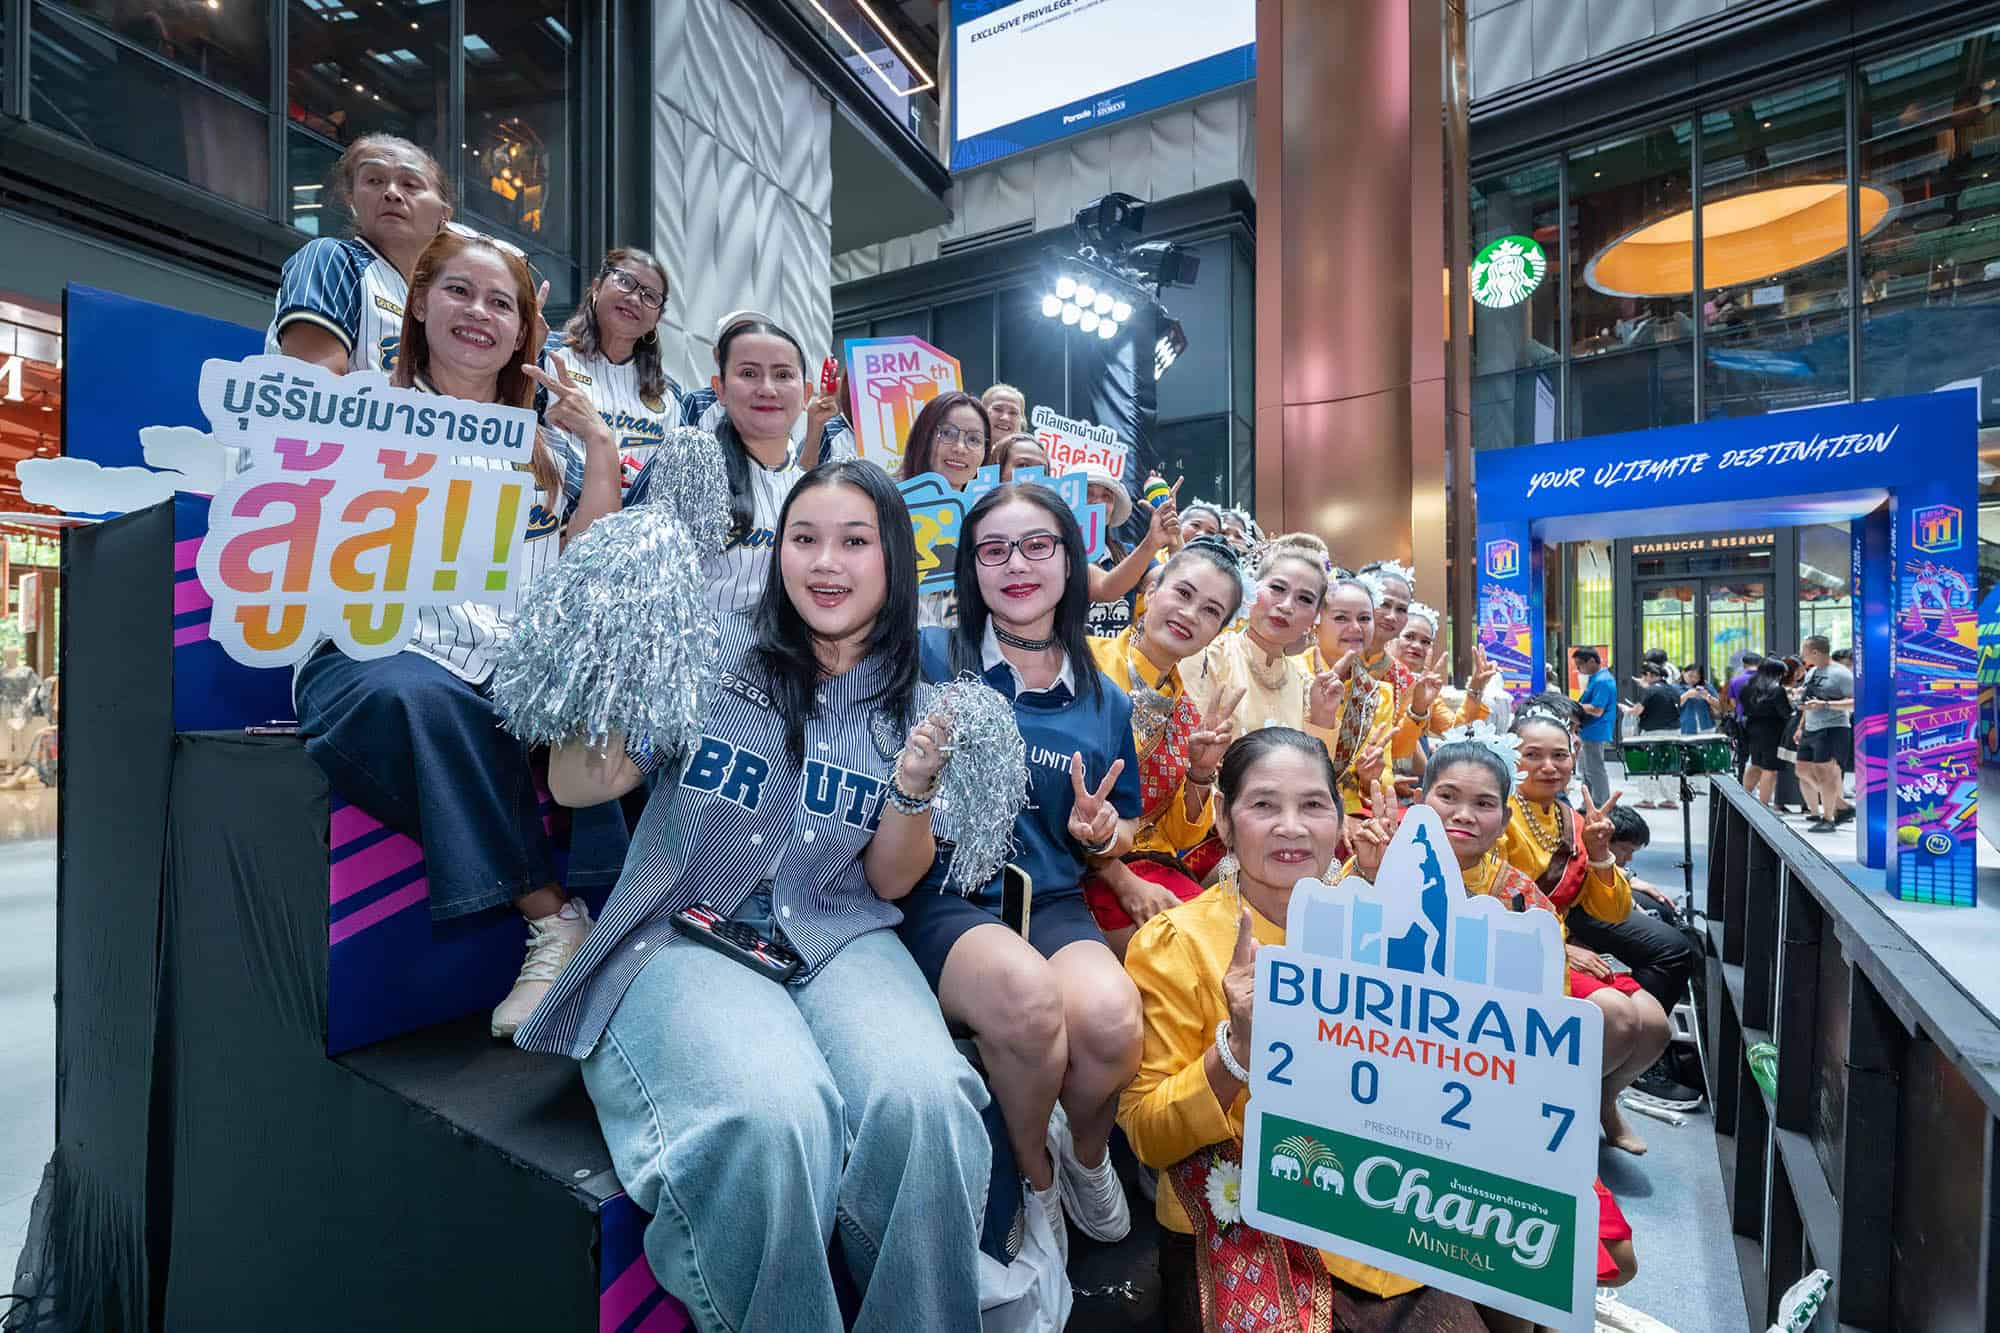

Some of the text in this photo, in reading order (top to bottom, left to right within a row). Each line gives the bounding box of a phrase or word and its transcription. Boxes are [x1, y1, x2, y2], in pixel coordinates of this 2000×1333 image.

[970, 16, 1022, 43] EXCLUSIVE
[865, 351, 950, 380] BRM th
[222, 371, 526, 450] บุรีรัมย์มาราธอน
[1527, 423, 1900, 498] YOUR ULTIMATE DESTINATION
[1632, 533, 1775, 554] STARBUCKS RESERVE
[679, 733, 772, 814] BR
[1030, 745, 1087, 778] UNIT
[1267, 959, 1582, 1067] BURIRAM
[1316, 1018, 1516, 1085] MARATHON
[1363, 1118, 1453, 1151] PRESENTED BY
[1352, 1155, 1561, 1270] Chang
[1407, 1226, 1496, 1272] MINERAL
